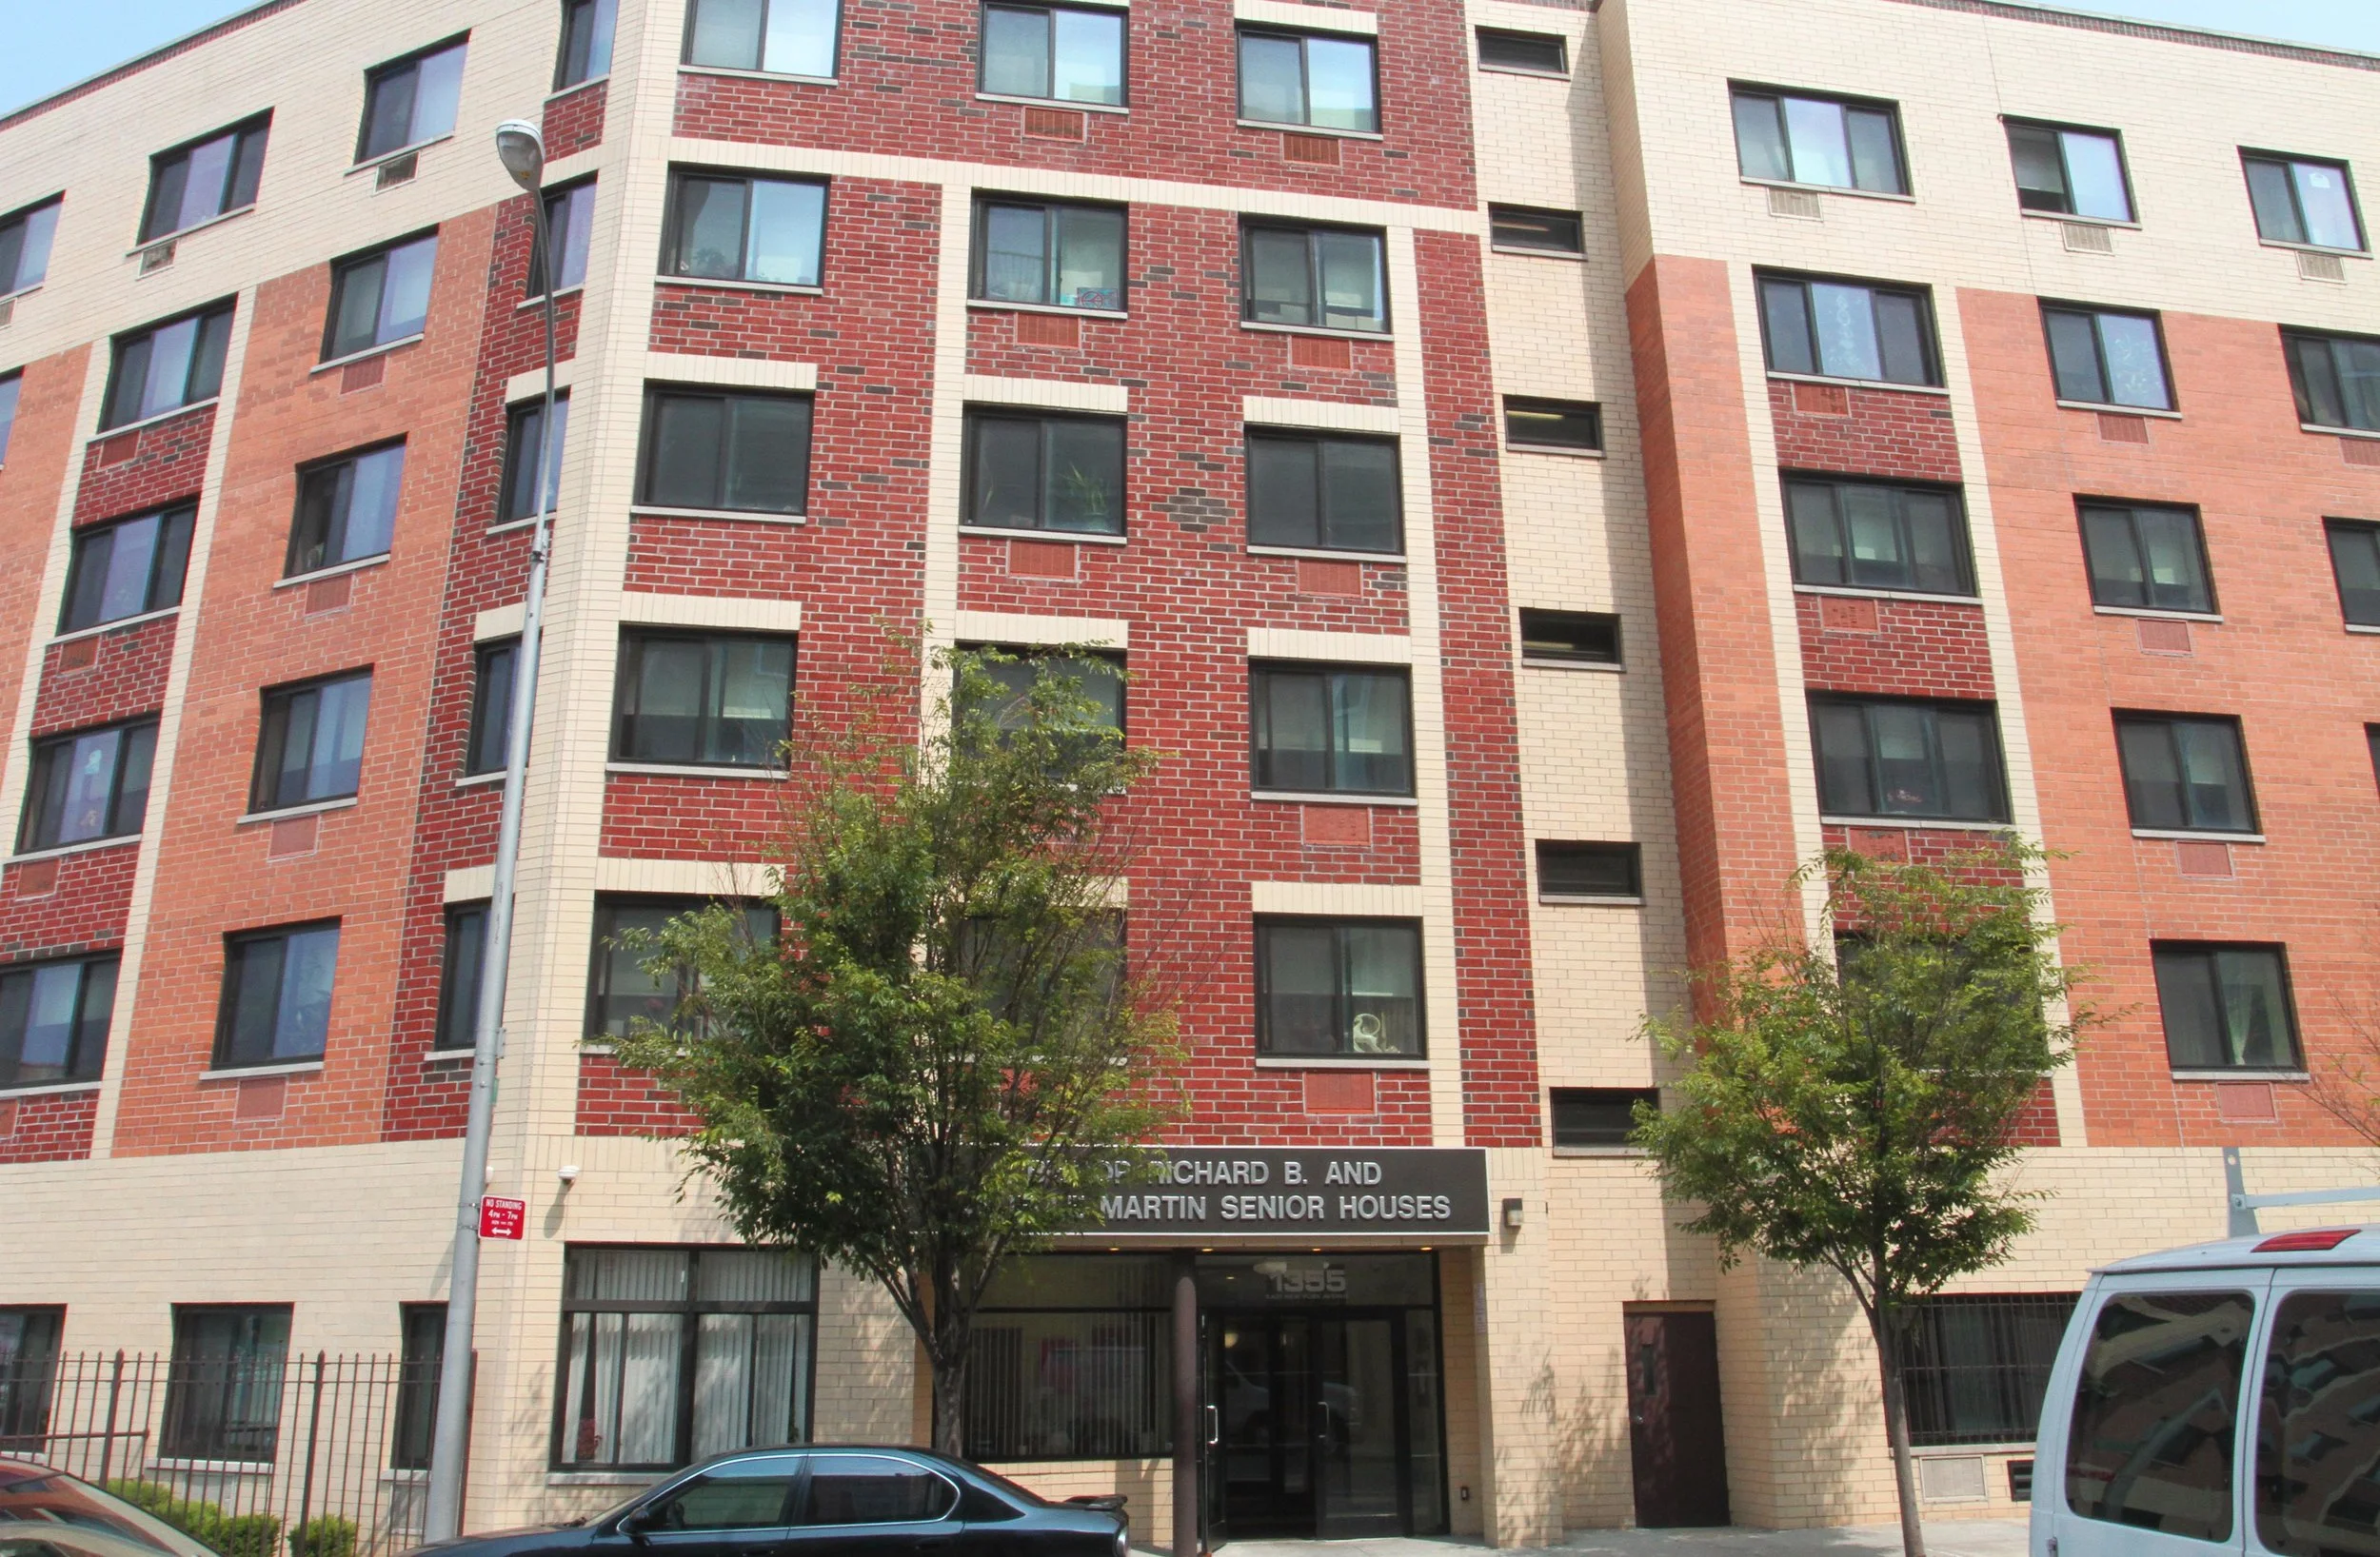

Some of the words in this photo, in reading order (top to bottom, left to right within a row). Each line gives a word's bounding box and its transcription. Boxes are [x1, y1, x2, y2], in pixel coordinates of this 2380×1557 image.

[1284, 1161, 1308, 1185] B.
[1324, 1161, 1382, 1185] AND
[486, 1199, 494, 1208] NO
[495, 1200, 523, 1211] STANDING
[1100, 1195, 1206, 1220] MARTIN
[1220, 1195, 1325, 1220] SENIOR
[1339, 1195, 1451, 1220] HOUSES
[1267, 1269, 1346, 1292] 1355
